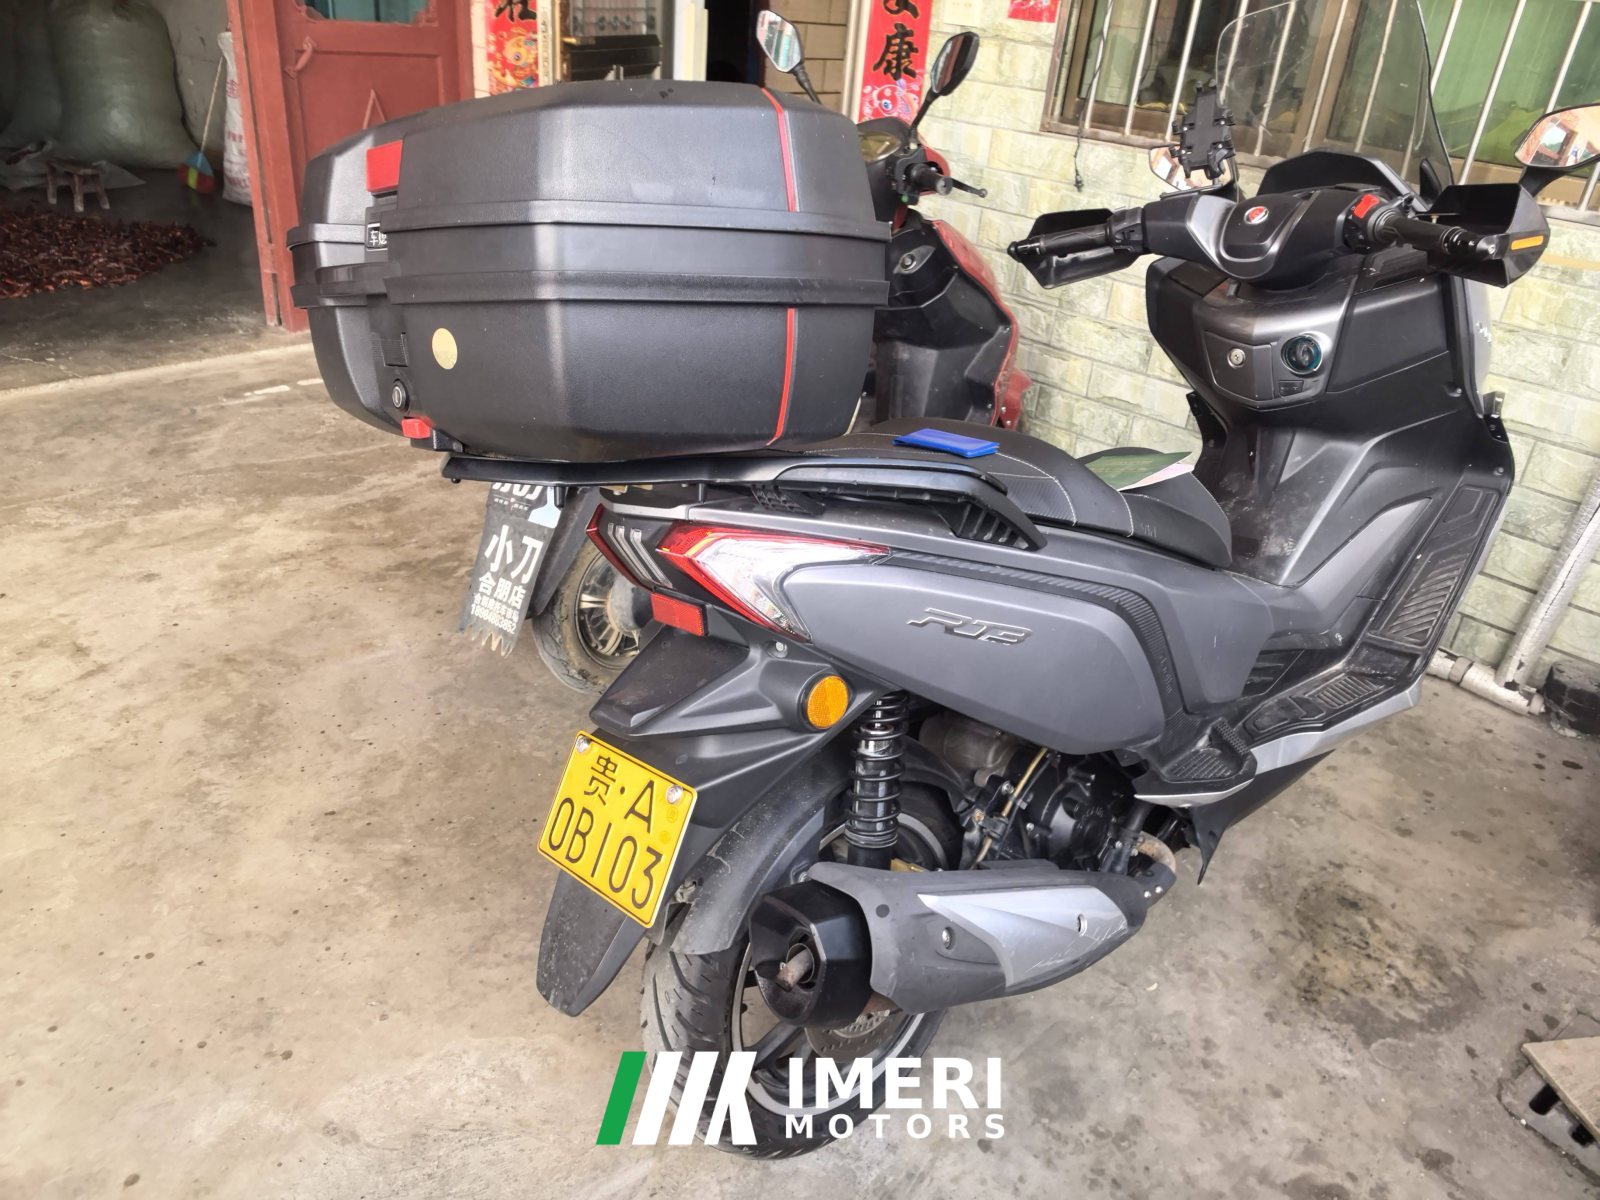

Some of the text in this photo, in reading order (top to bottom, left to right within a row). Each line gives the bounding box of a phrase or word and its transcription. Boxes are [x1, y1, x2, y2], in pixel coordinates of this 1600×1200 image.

[484, 524, 544, 584] 小刀
[478, 571, 527, 610] 合朋店
